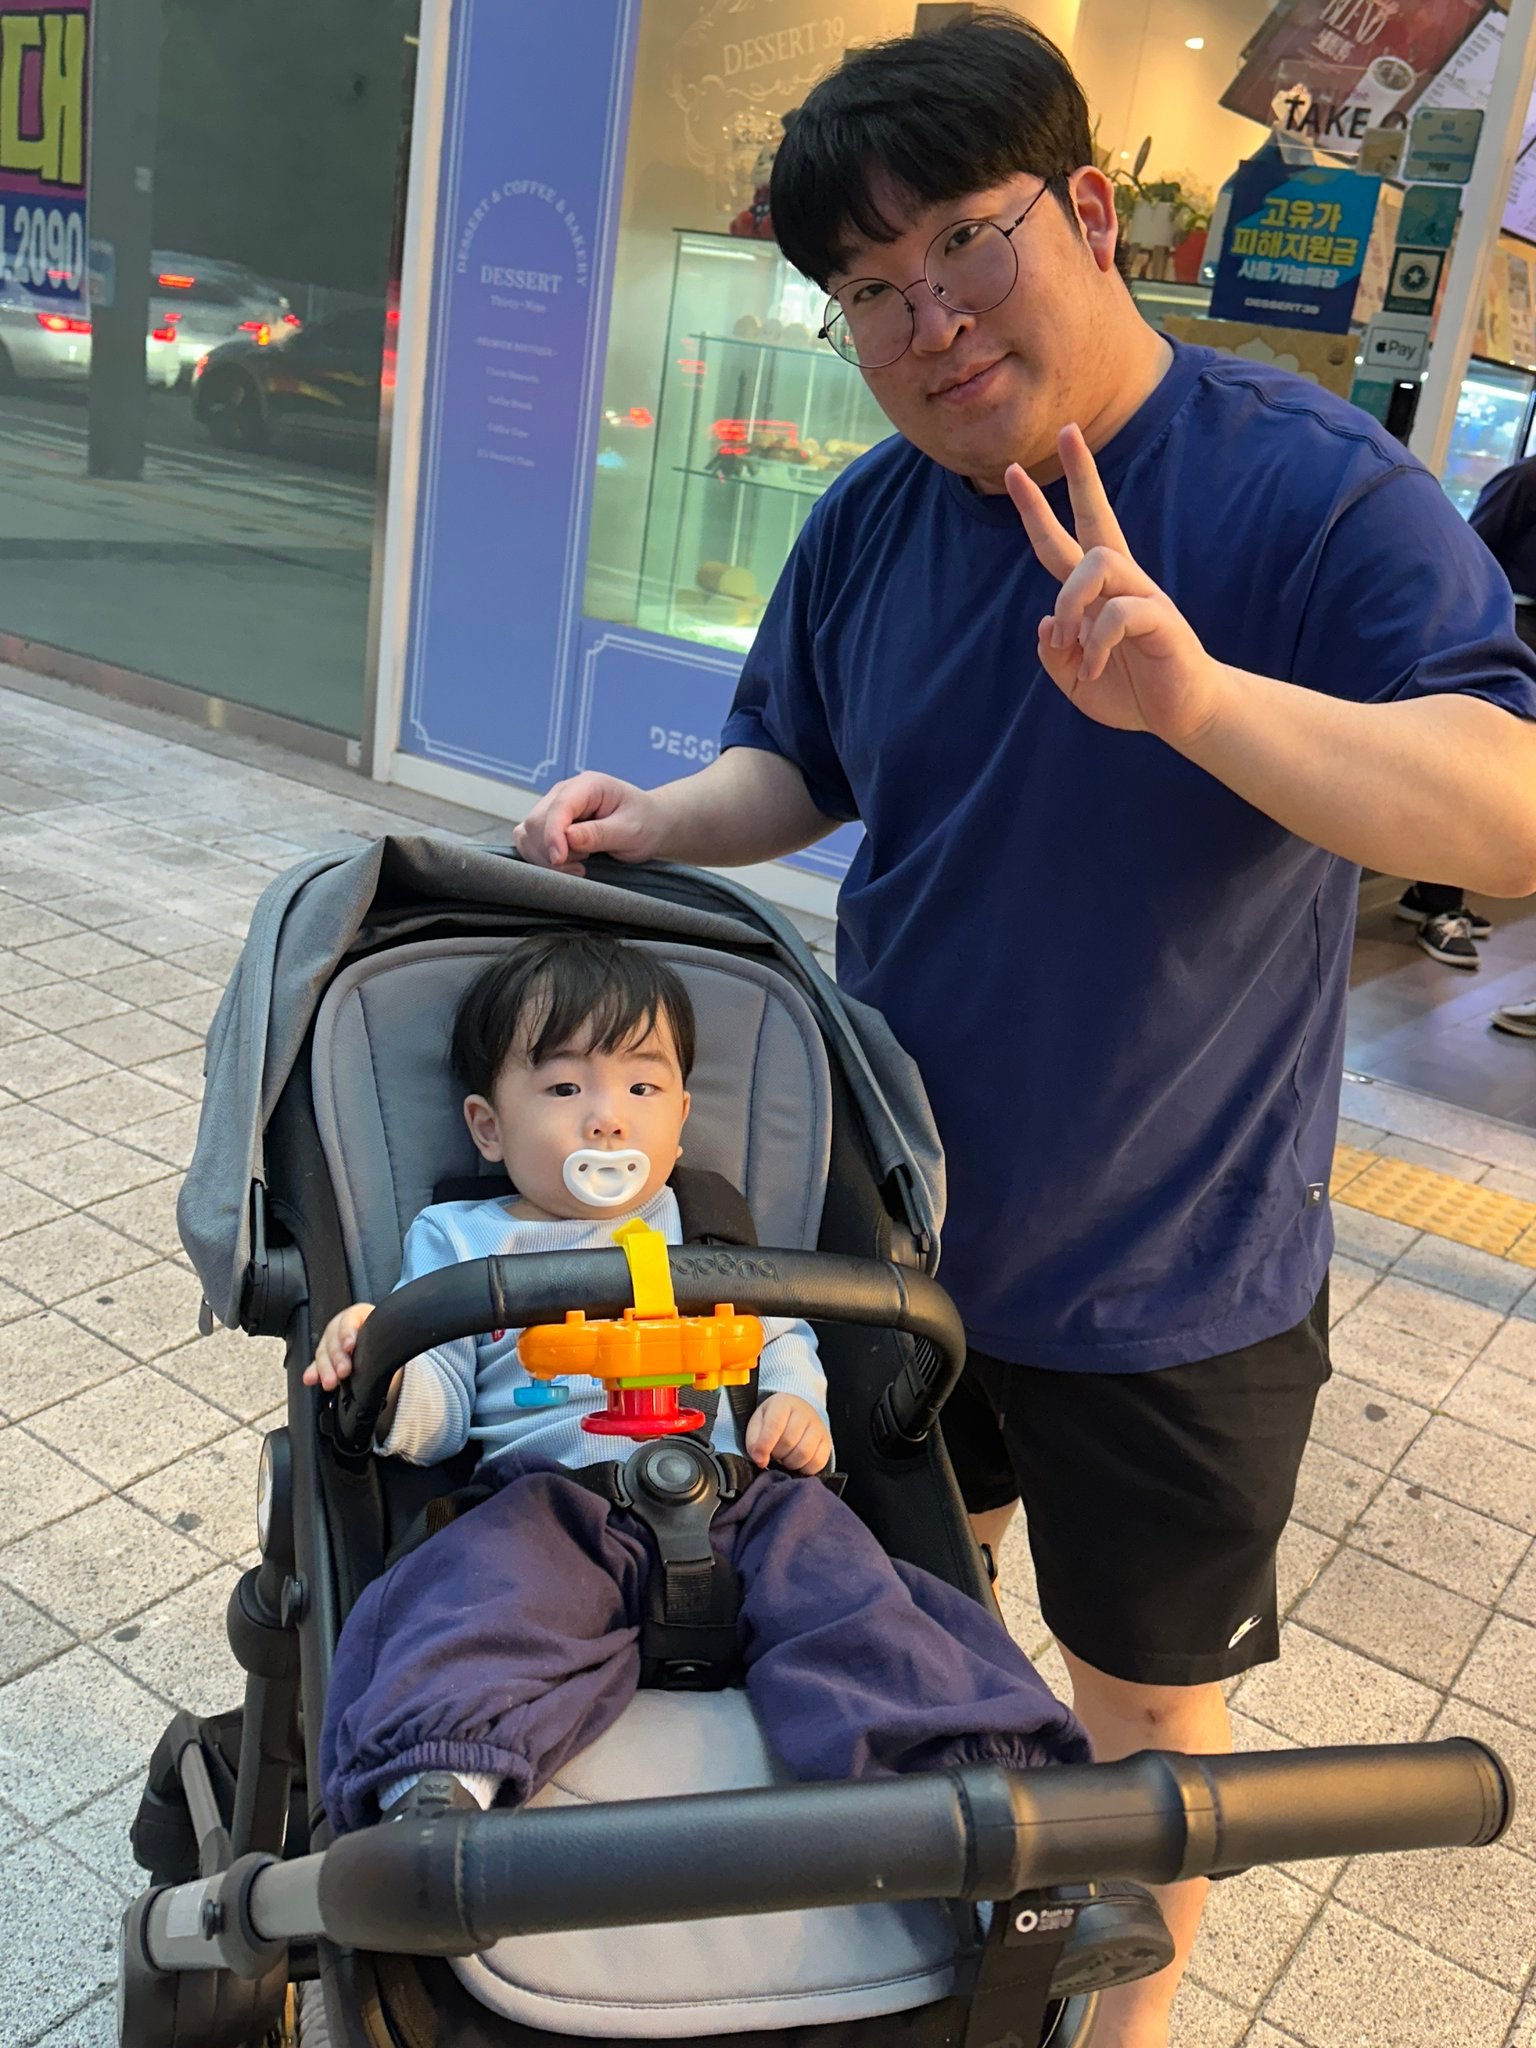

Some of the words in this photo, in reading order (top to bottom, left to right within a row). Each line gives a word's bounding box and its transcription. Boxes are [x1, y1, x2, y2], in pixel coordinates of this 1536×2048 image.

[723, 21, 818, 77] DESSERT
[821, 15, 845, 50] 39
[1285, 94, 1372, 139] TAKE
[1259, 197, 1343, 233] 고유가
[1231, 227, 1359, 267] 피해지원금
[480, 265, 562, 294] DESSERT
[1388, 339, 1418, 361] Pay
[650, 725, 721, 765] DESS
